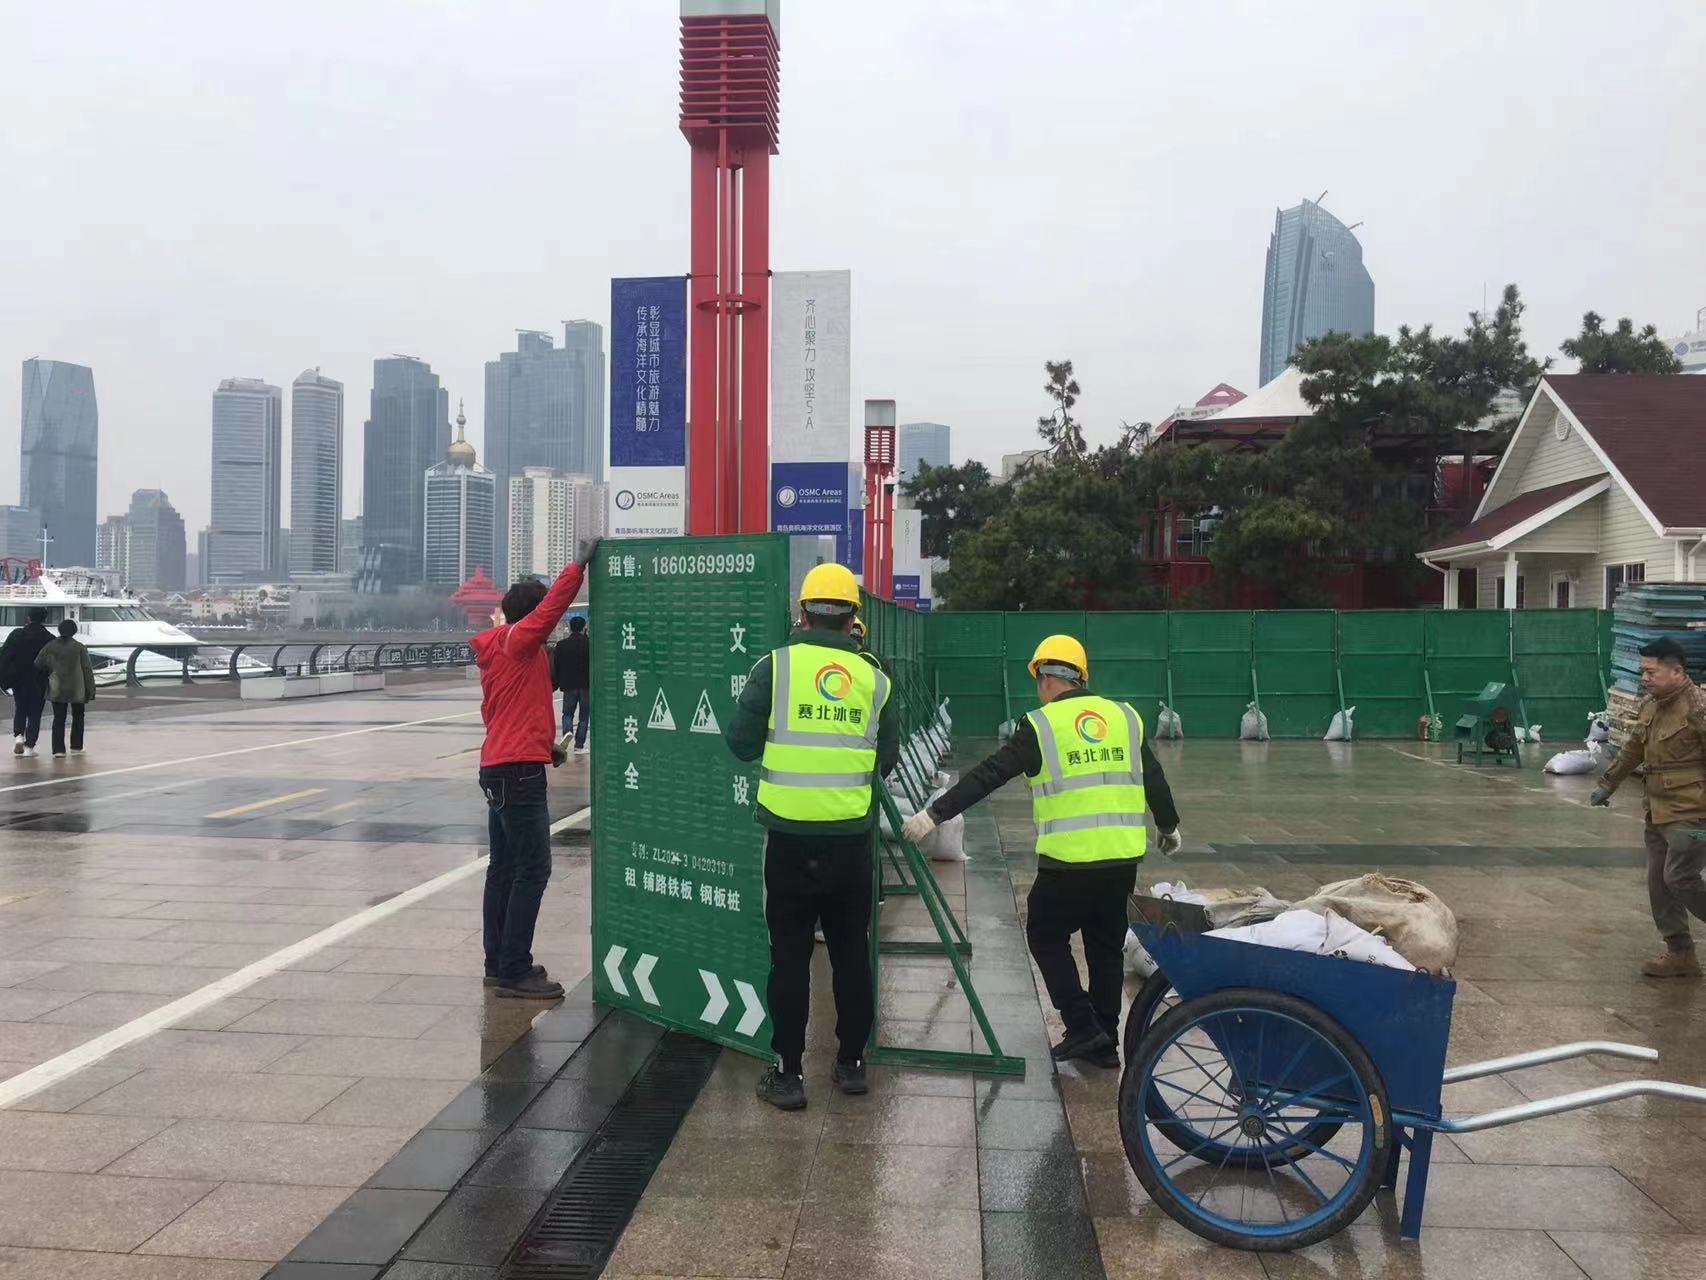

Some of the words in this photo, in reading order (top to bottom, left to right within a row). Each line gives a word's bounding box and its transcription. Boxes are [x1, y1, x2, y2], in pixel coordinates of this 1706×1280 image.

[804, 299, 816, 361] 齐心聚力
[635, 306, 647, 432] 传承海洋文化精髓
[649, 305, 661, 432] 彰显城市旅游魅力
[636, 492, 658, 500] OSMC
[659, 492, 679, 500] Areas
[798, 488, 820, 496] OSMC
[652, 553, 755, 575] 18603699999
[622, 622, 640, 790] 注意安全
[798, 704, 862, 724] 赛北冰雪
[1067, 747, 1124, 766] 赛北冰雪
[624, 866, 636, 887] 租
[643, 870, 693, 900] 铺路铁板
[700, 883, 740, 912] 钢板桩
